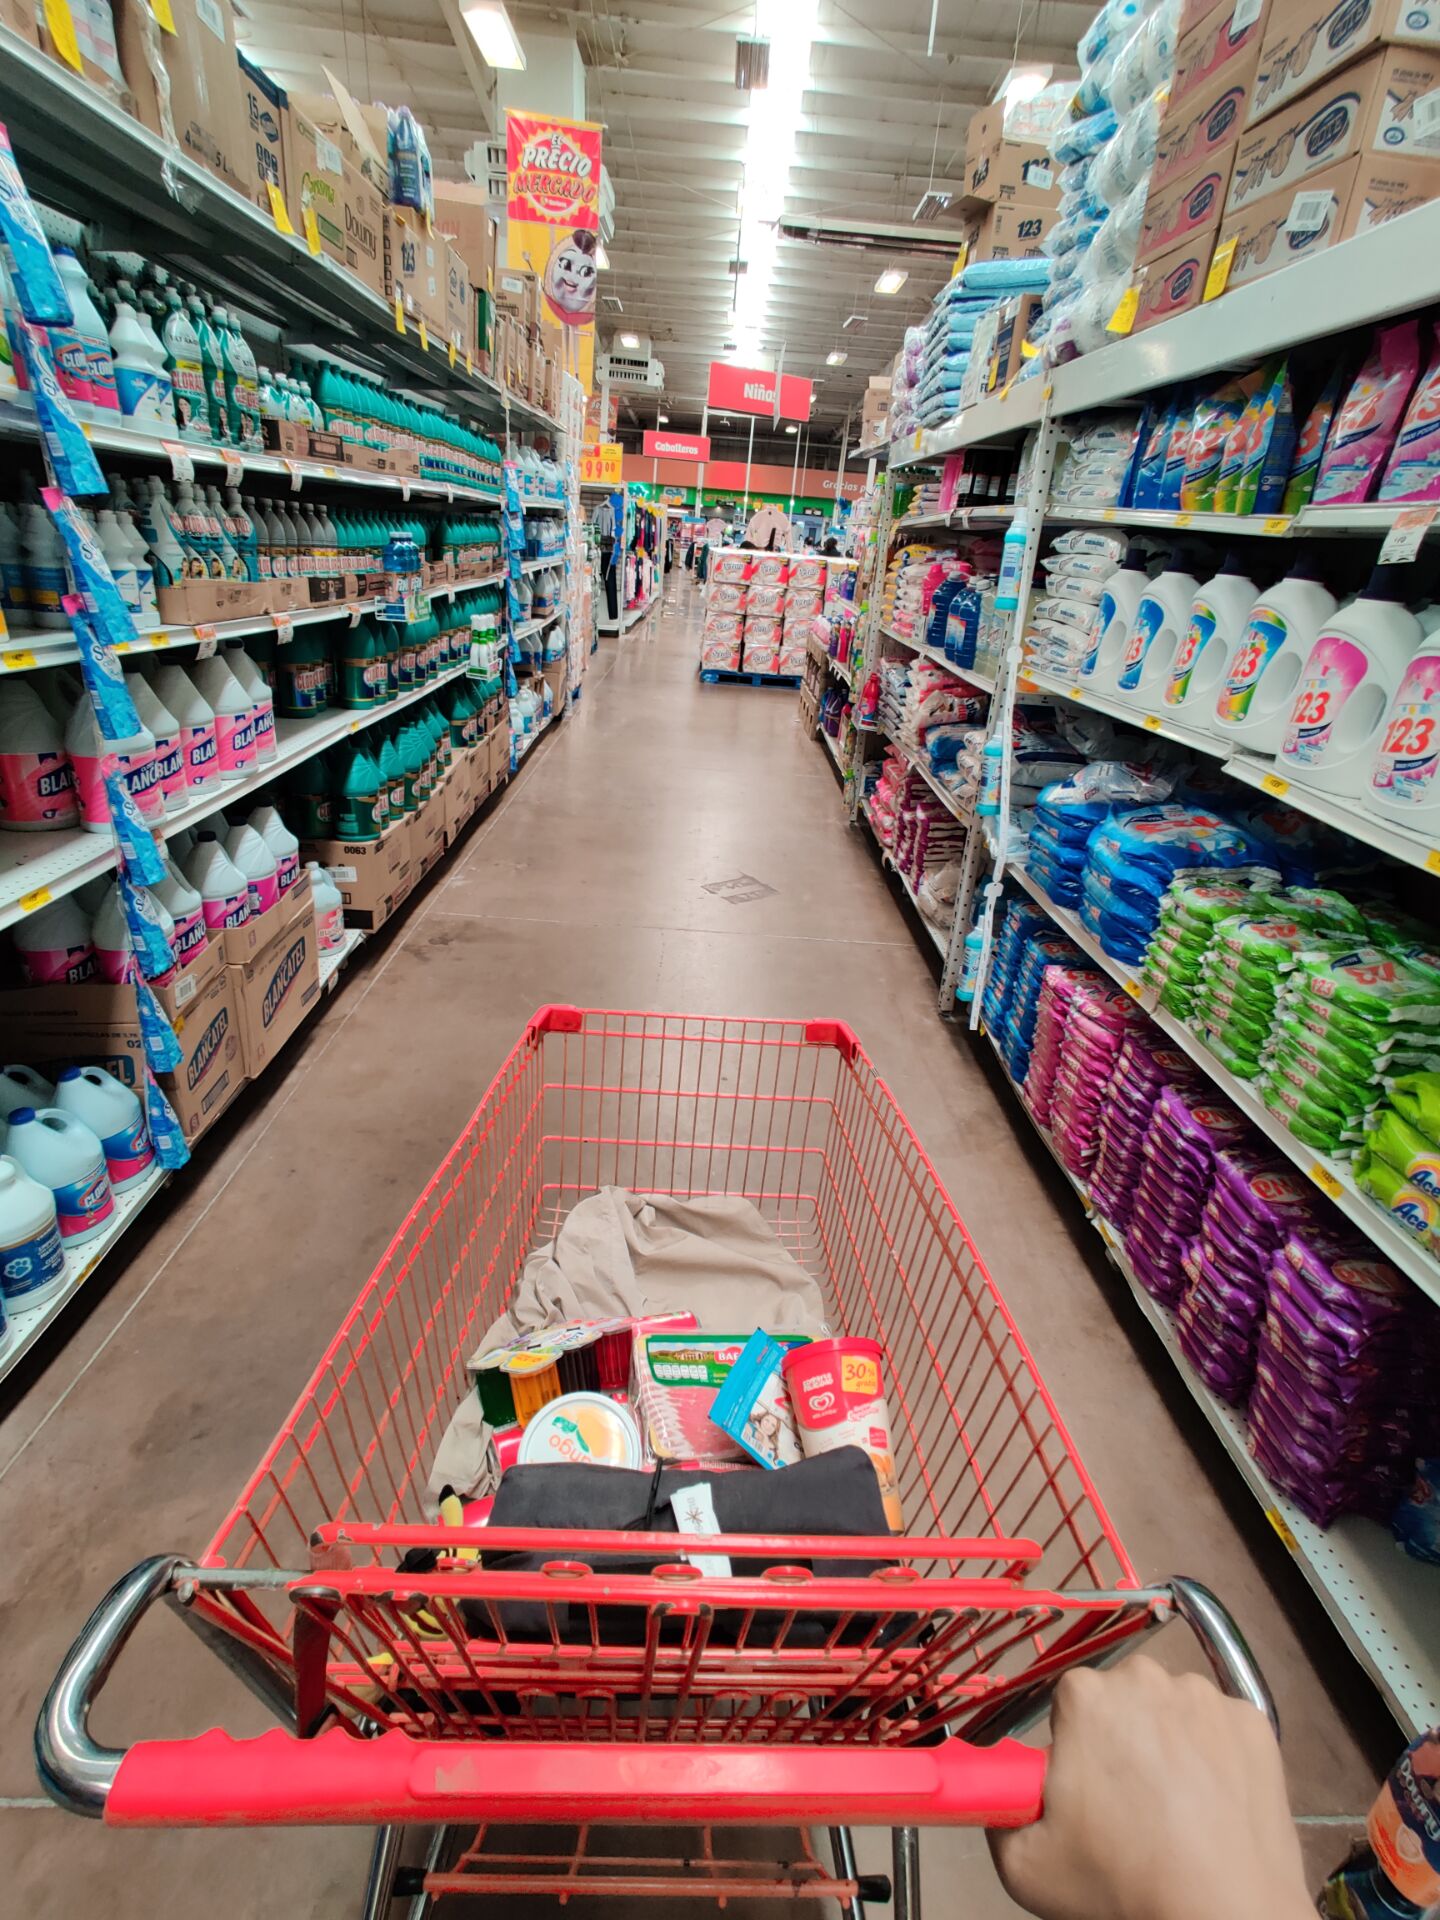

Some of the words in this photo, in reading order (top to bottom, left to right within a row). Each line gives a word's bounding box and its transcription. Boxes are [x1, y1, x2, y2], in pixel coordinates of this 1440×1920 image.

[522, 146, 593, 178] PRECIO
[513, 173, 597, 204] MERCADO
[345, 203, 377, 261] Downy
[1018, 219, 1042, 239] 123
[743, 382, 777, 403] Niño
[655, 440, 699, 456] Caballeros
[822, 479, 858, 492] Gracias
[1226, 647, 1262, 679] 123
[1289, 691, 1331, 725] 123
[1381, 717, 1436, 755] 123
[1311, 978, 1335, 997] 123
[1408, 1169, 1440, 1197] Ace
[1391, 1202, 1429, 1232] Ace
[1400, 1757, 1440, 1841] Downy
